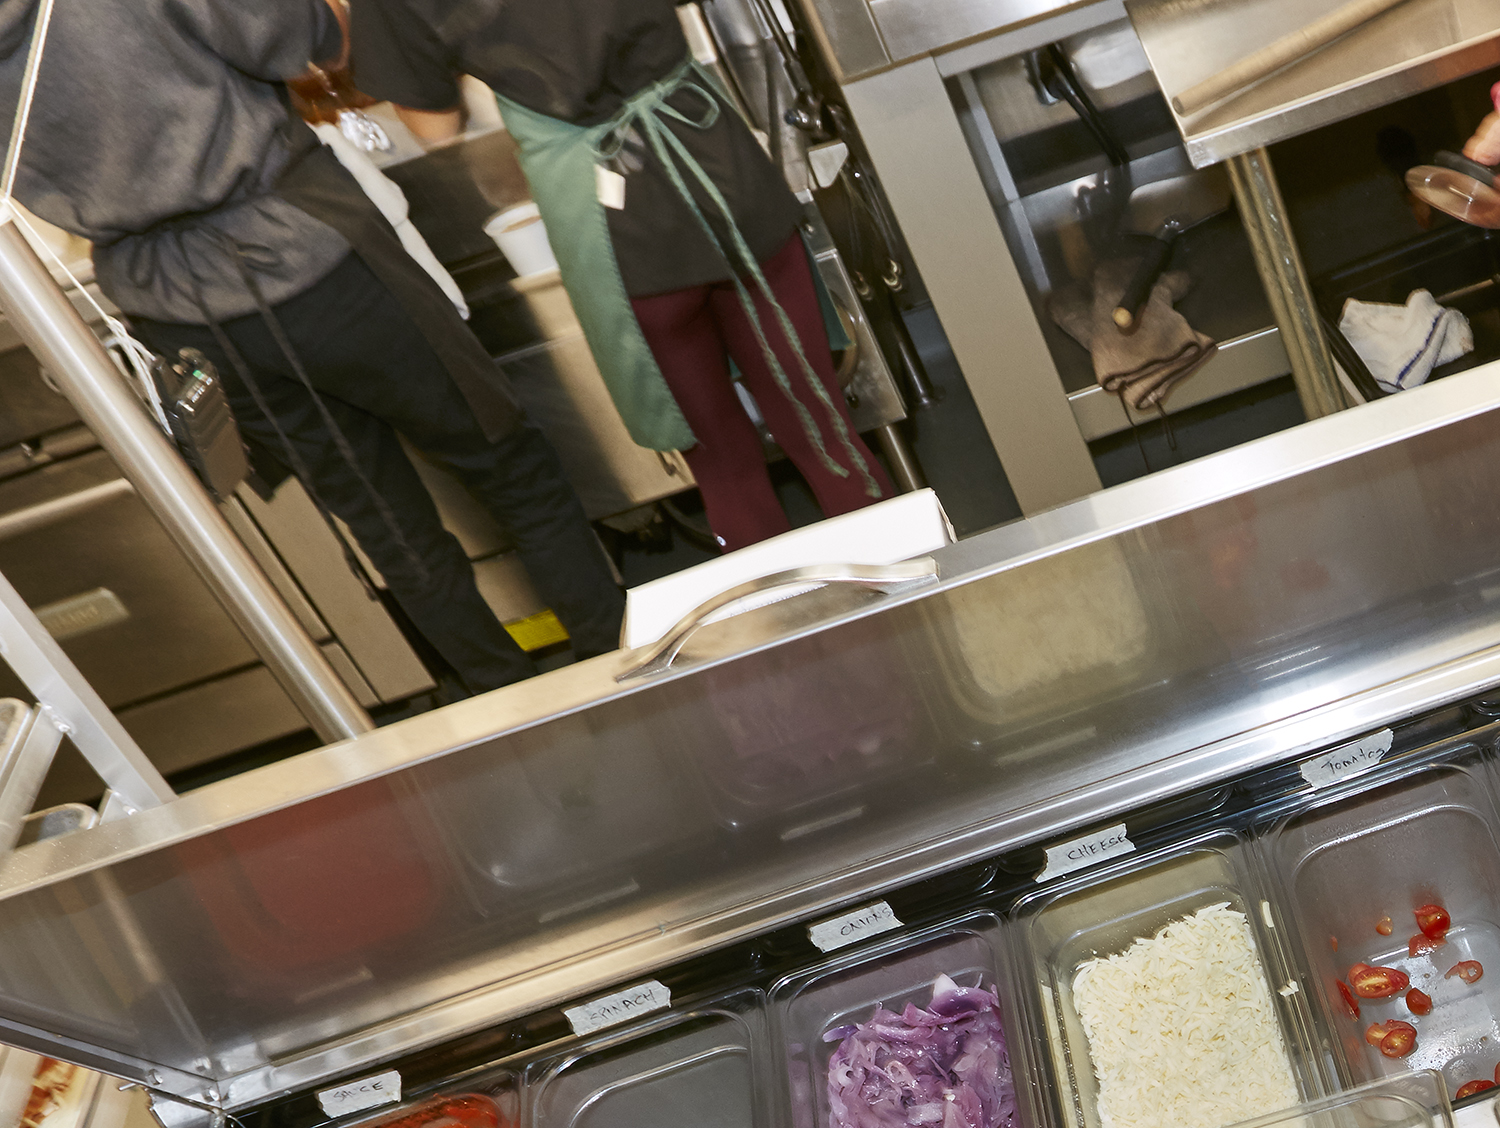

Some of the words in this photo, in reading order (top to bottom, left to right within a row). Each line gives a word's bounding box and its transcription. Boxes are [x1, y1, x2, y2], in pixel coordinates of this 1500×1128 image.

[1067, 832, 1126, 860] CHEESE
[840, 907, 891, 936] ONIONS
[589, 989, 657, 1026] SPINACH
[333, 1081, 384, 1103] SAUCE
